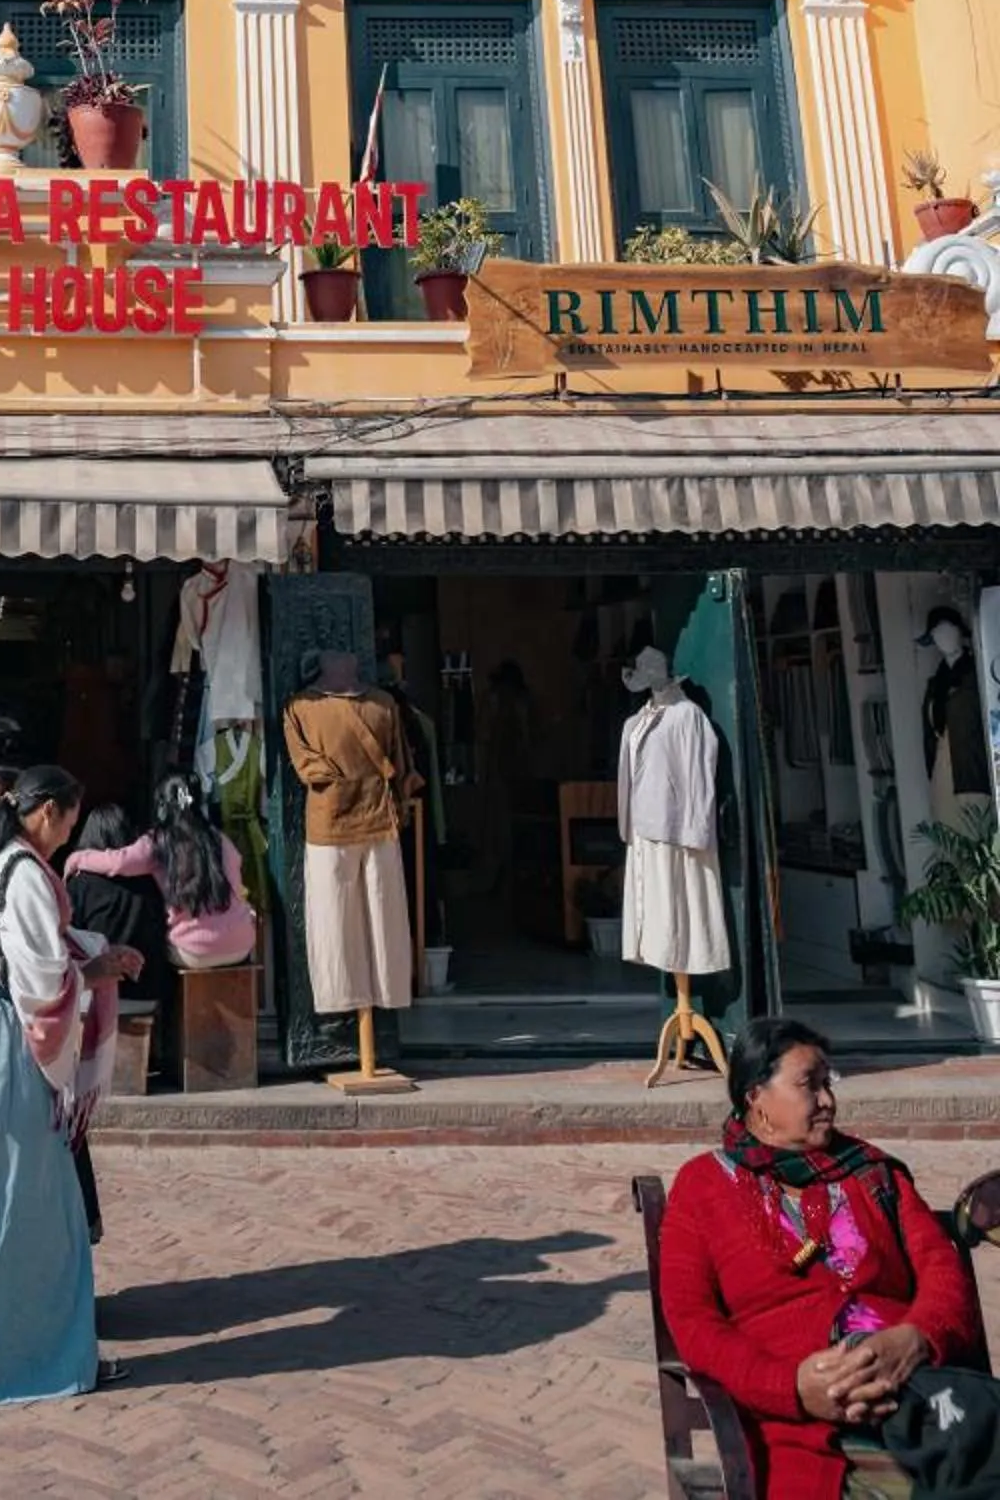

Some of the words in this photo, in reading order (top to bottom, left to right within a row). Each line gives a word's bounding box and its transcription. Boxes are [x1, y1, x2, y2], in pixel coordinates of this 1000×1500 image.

[49, 178, 427, 249] RESTAURANT
[7, 265, 205, 336] HOUSE
[543, 289, 887, 334] RIMTHIM
[823, 342, 867, 354] NEPAL
